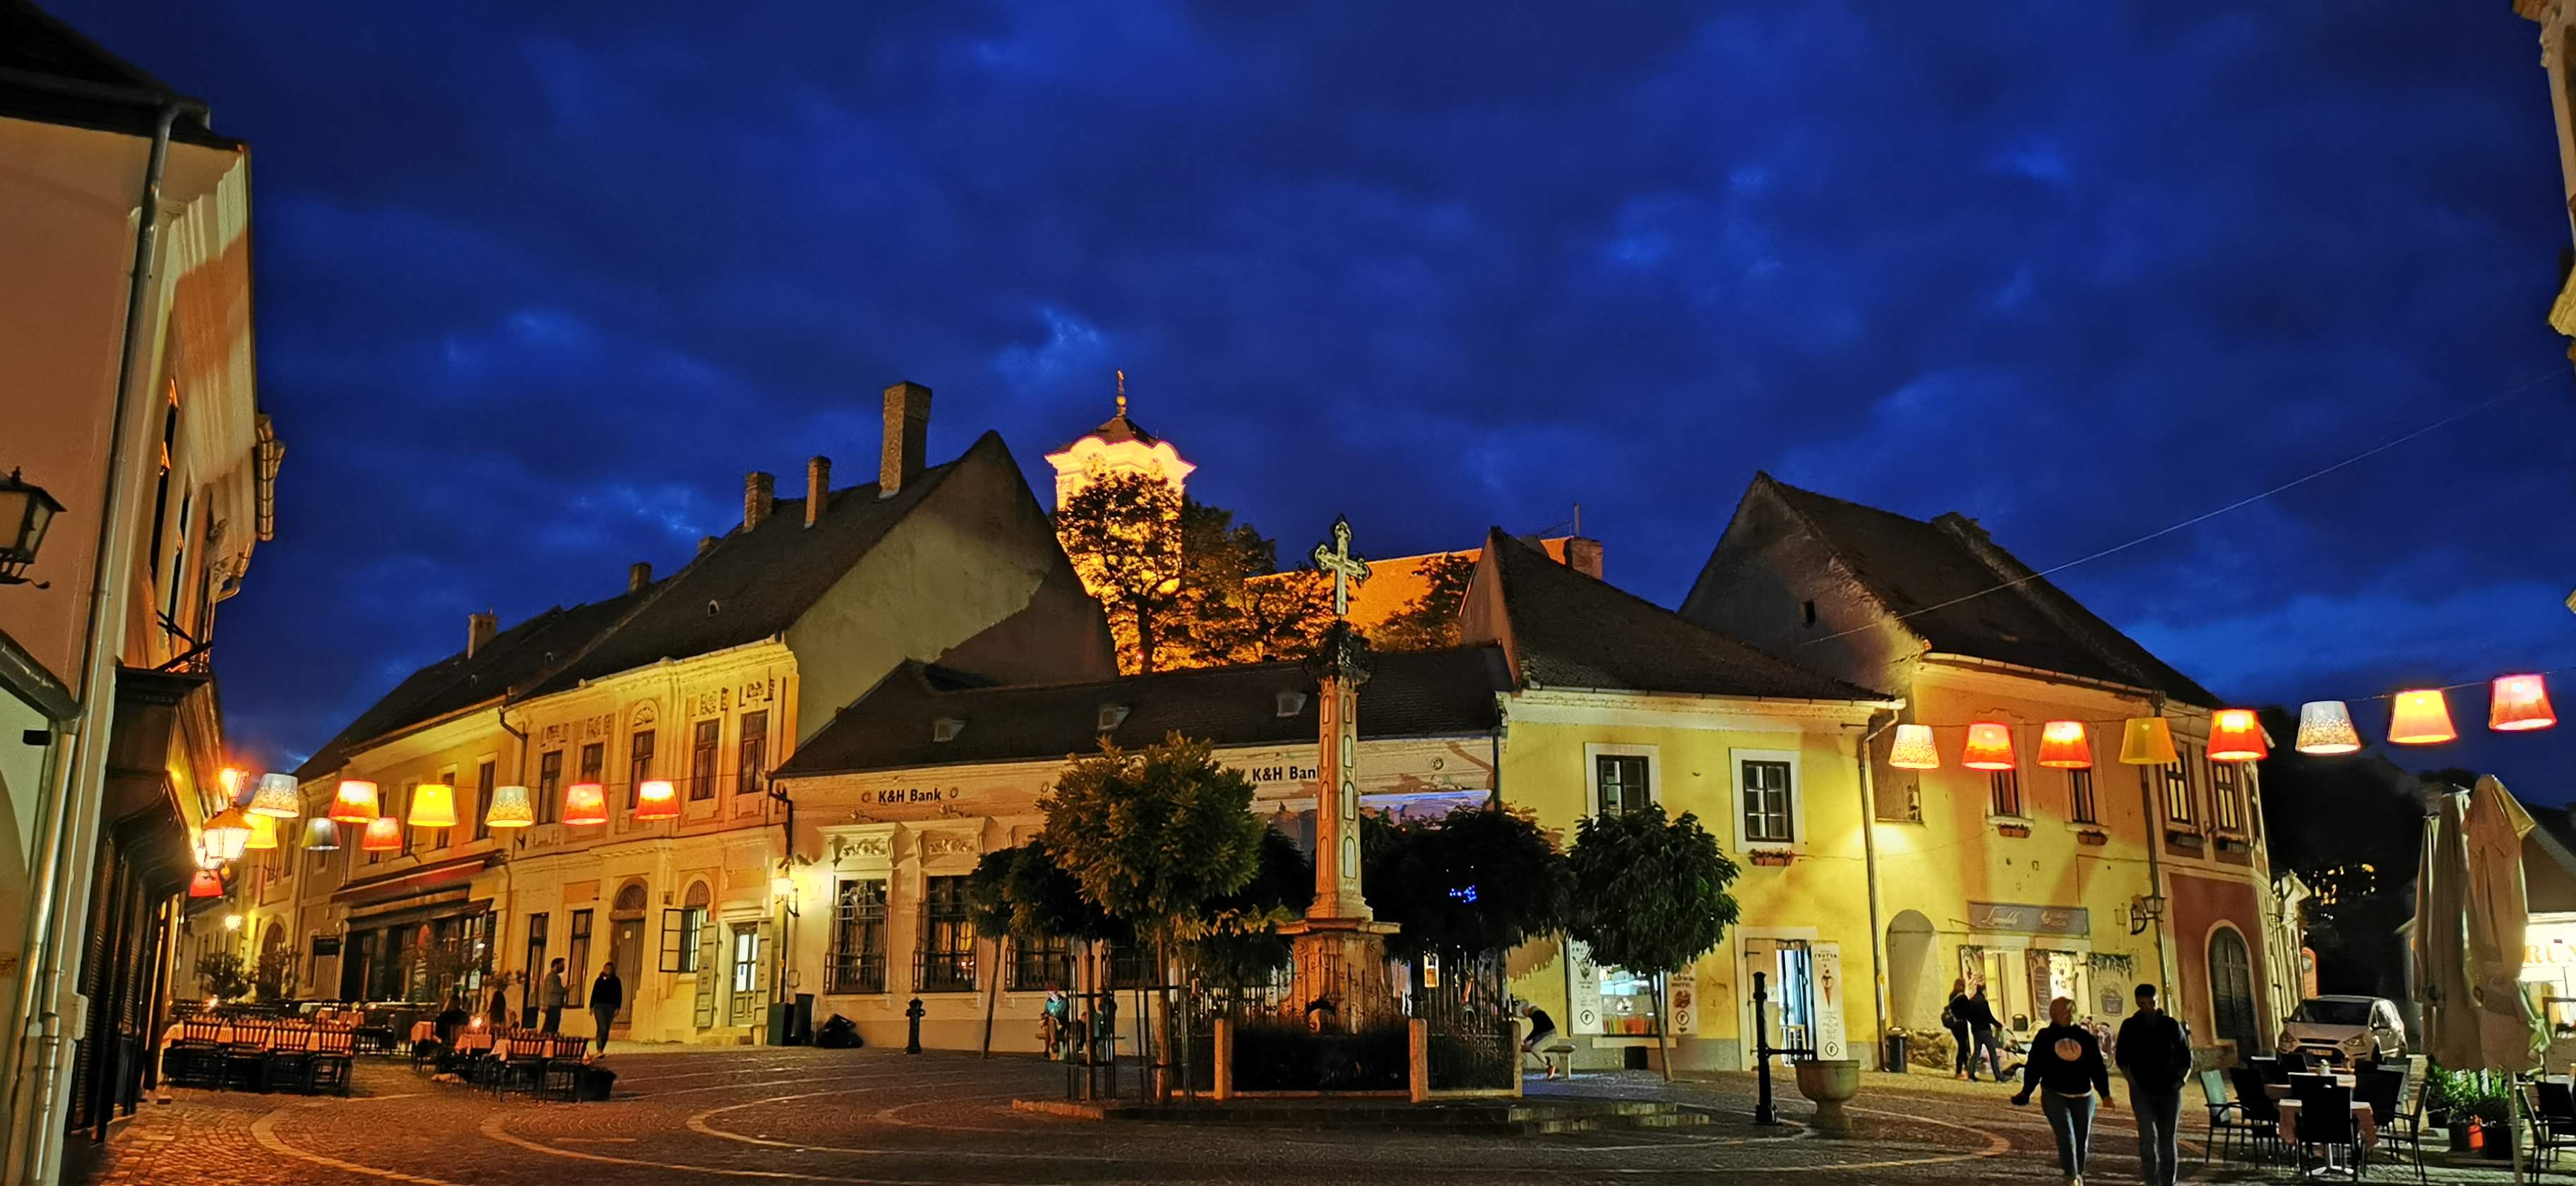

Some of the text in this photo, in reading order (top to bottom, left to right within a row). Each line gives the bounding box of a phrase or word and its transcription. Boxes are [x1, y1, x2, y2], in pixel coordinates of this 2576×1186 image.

[1253, 767, 1282, 781] K&H
[878, 787, 941, 803] K&H Bank
